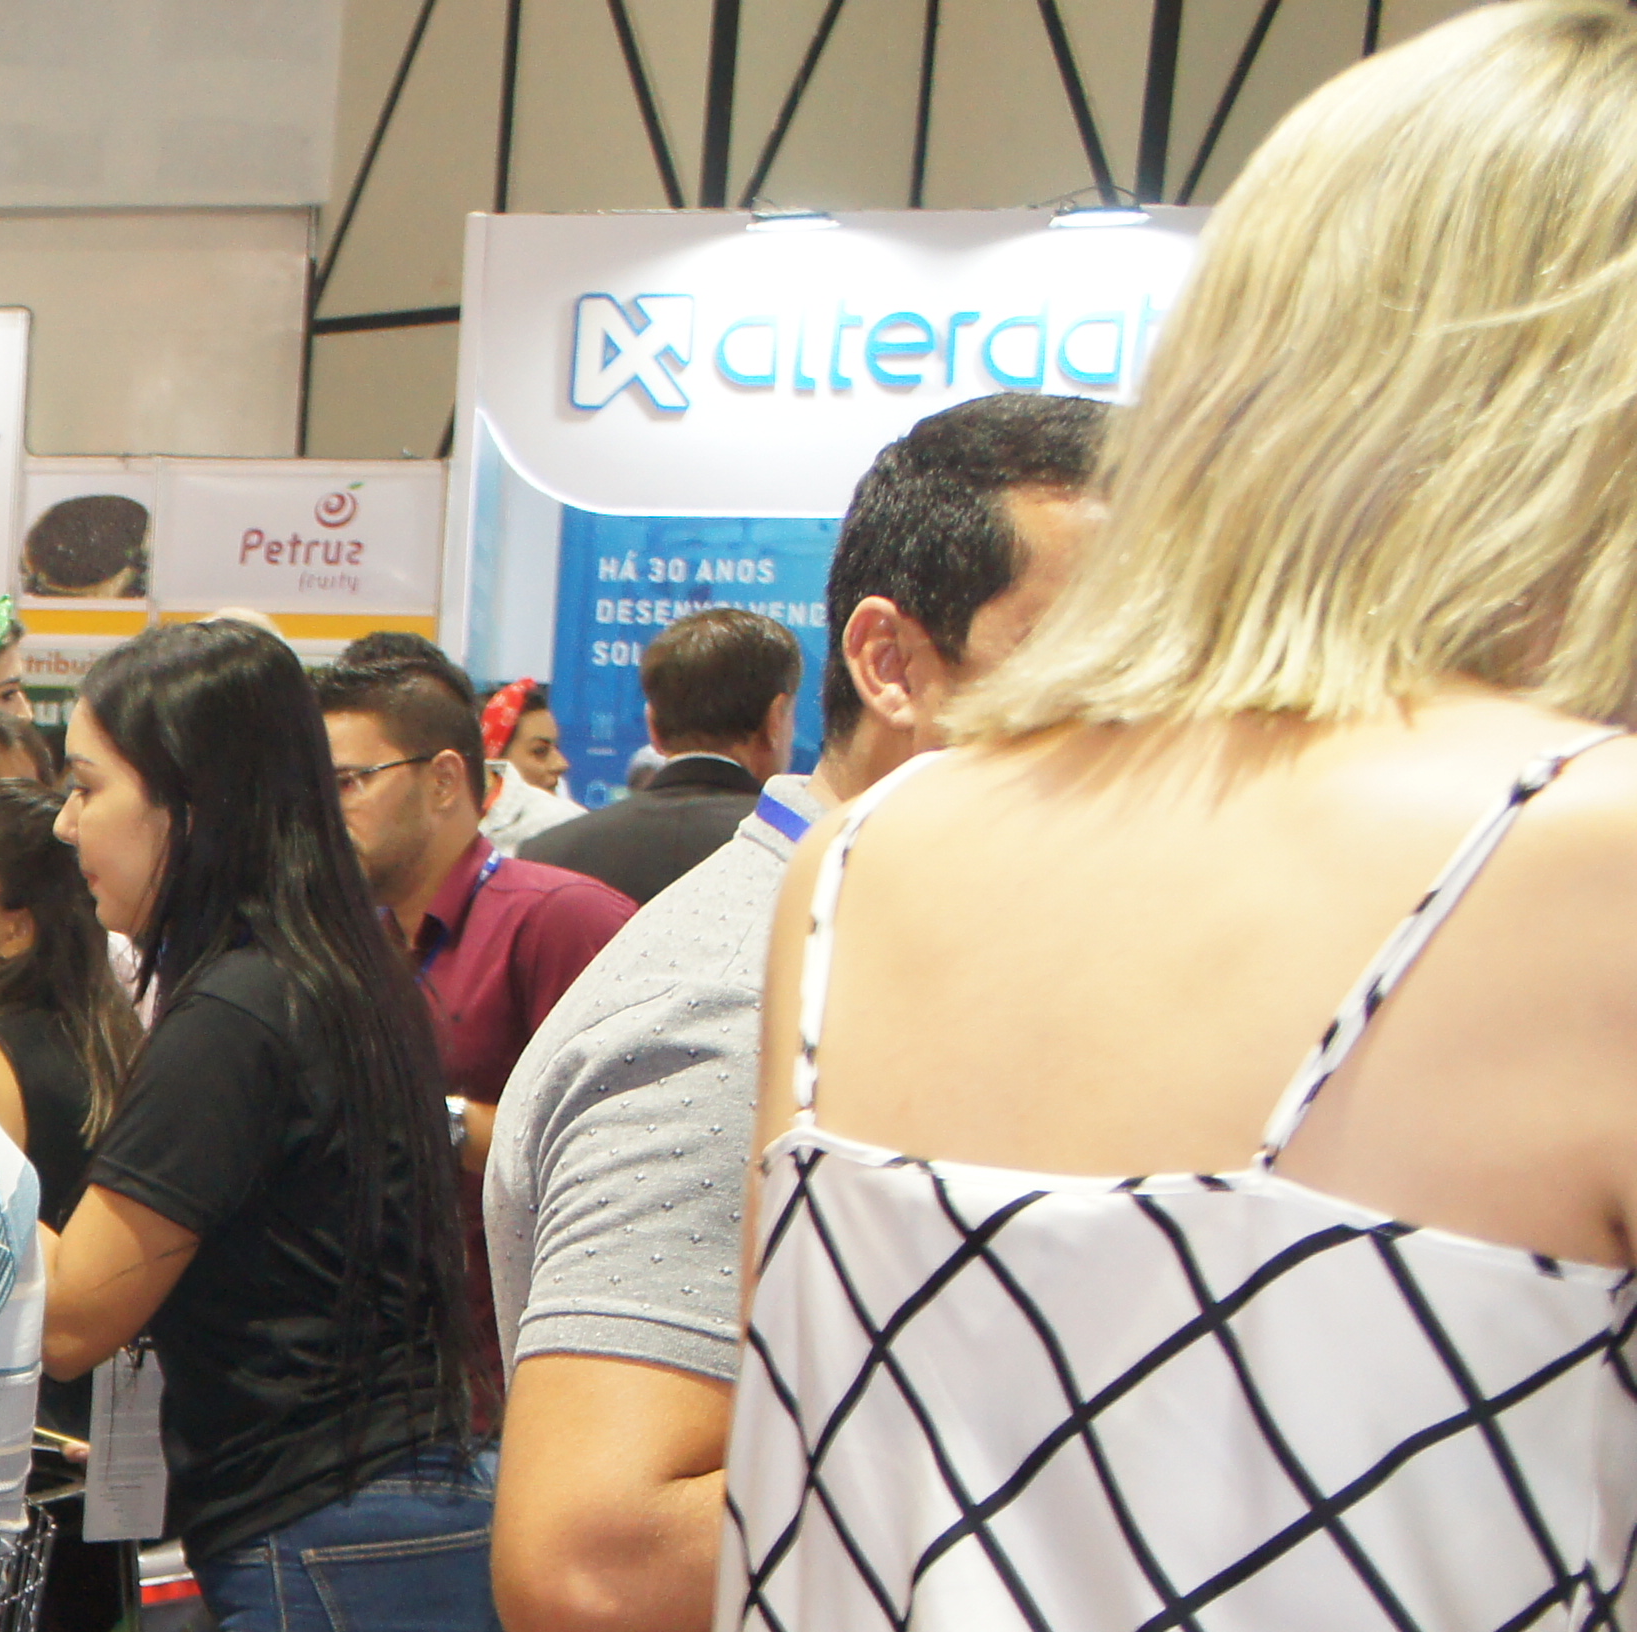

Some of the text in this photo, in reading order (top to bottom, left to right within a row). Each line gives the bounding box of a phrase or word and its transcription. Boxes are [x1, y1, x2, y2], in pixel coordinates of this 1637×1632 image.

[238, 527, 365, 566] Petruz
[597, 550, 775, 584] HÁ 30 ANOS
